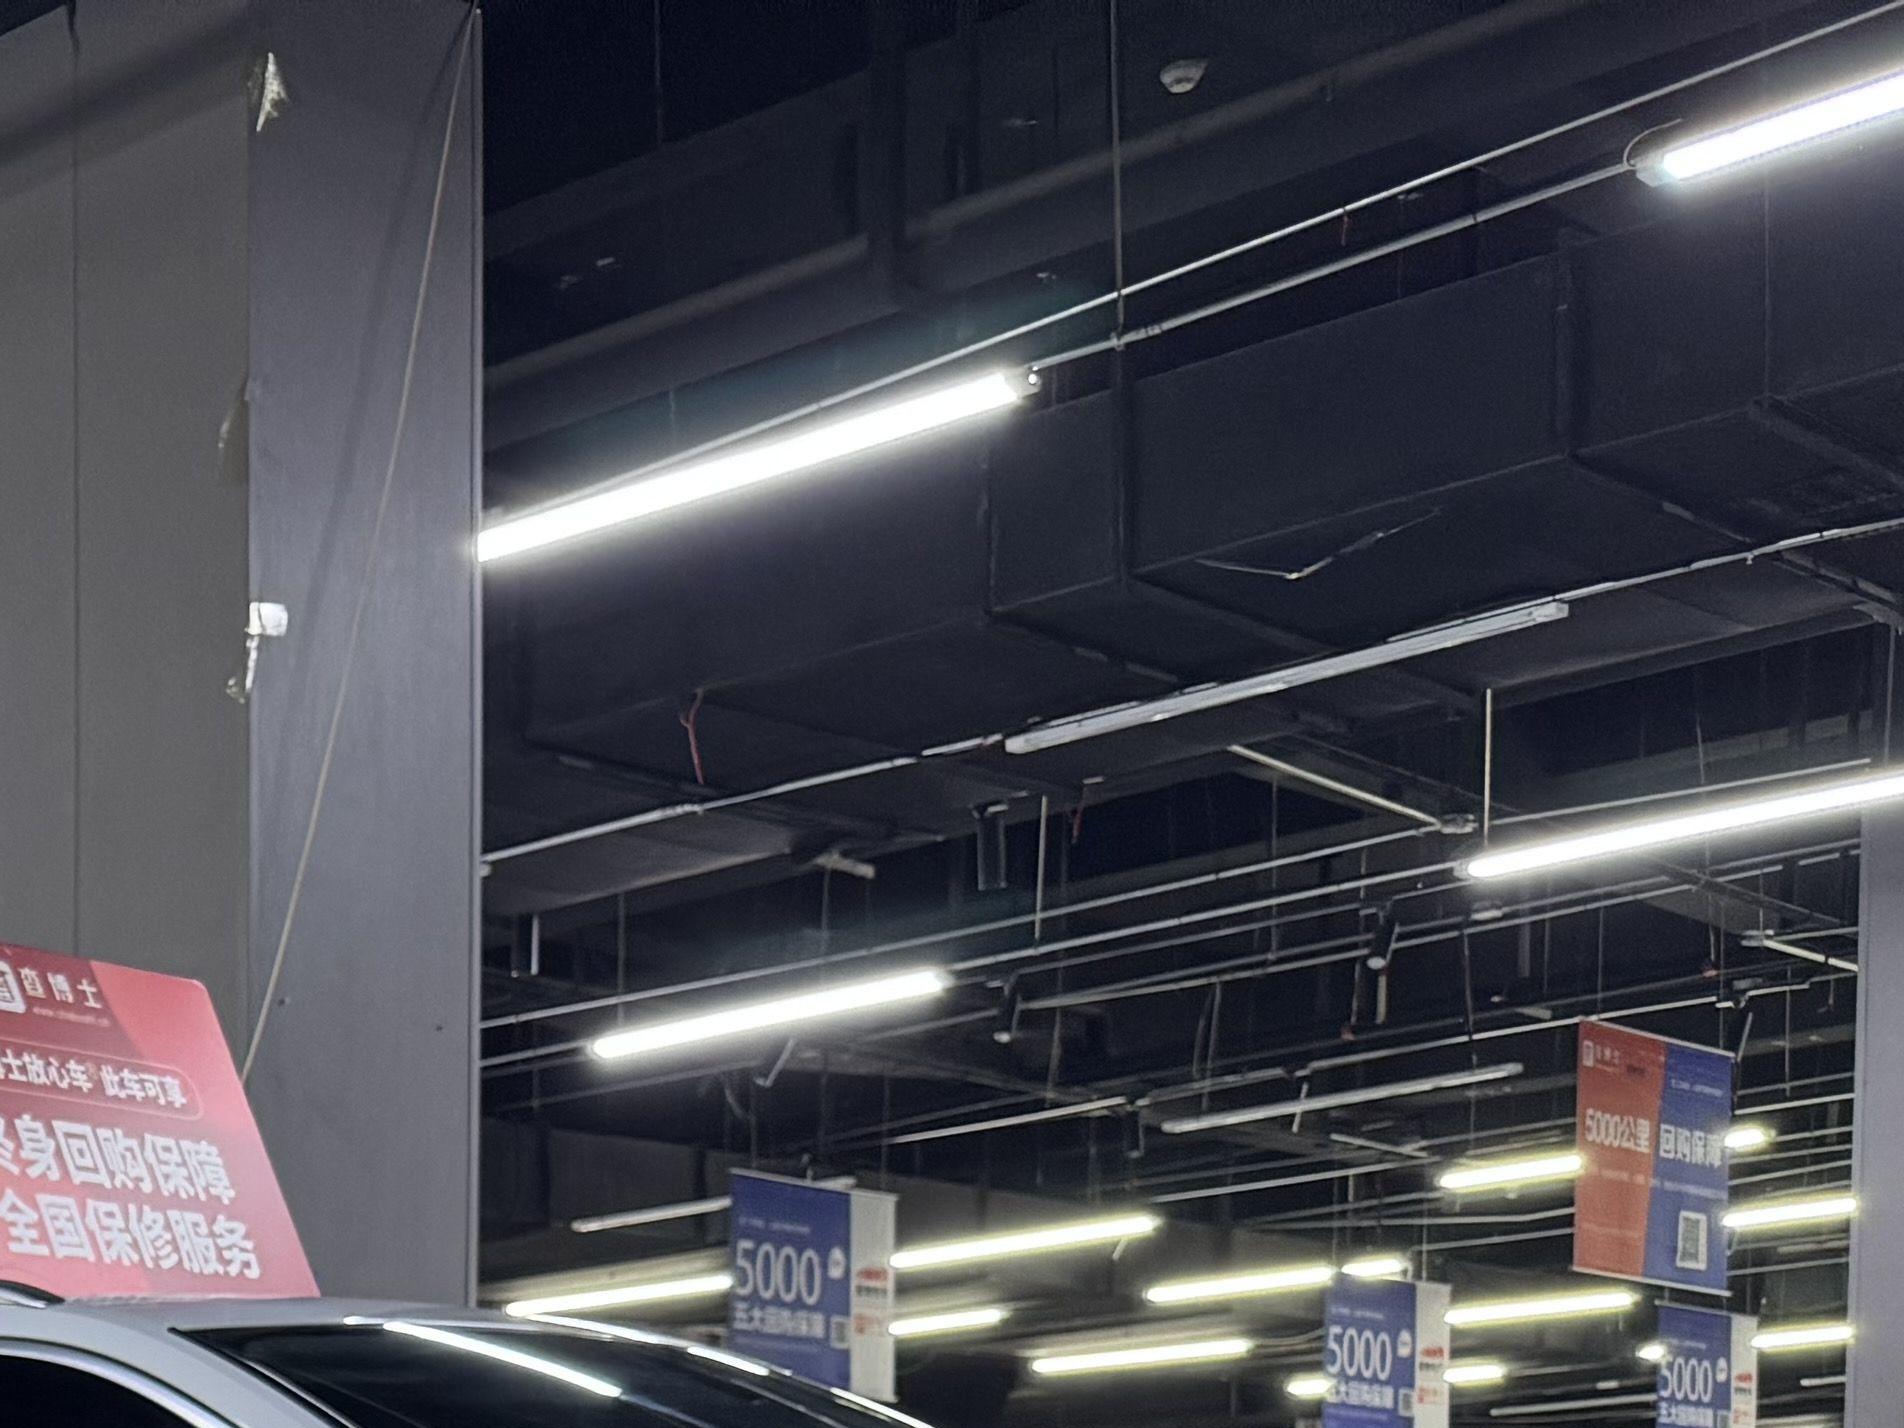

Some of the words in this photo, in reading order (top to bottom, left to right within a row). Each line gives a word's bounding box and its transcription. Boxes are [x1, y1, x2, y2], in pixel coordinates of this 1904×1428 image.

[17, 965, 104, 1009] 查博士
[99, 1064, 188, 1108] 此车可享
[735, 1238, 822, 1306] 5000
[1327, 1325, 1392, 1381] 5000
